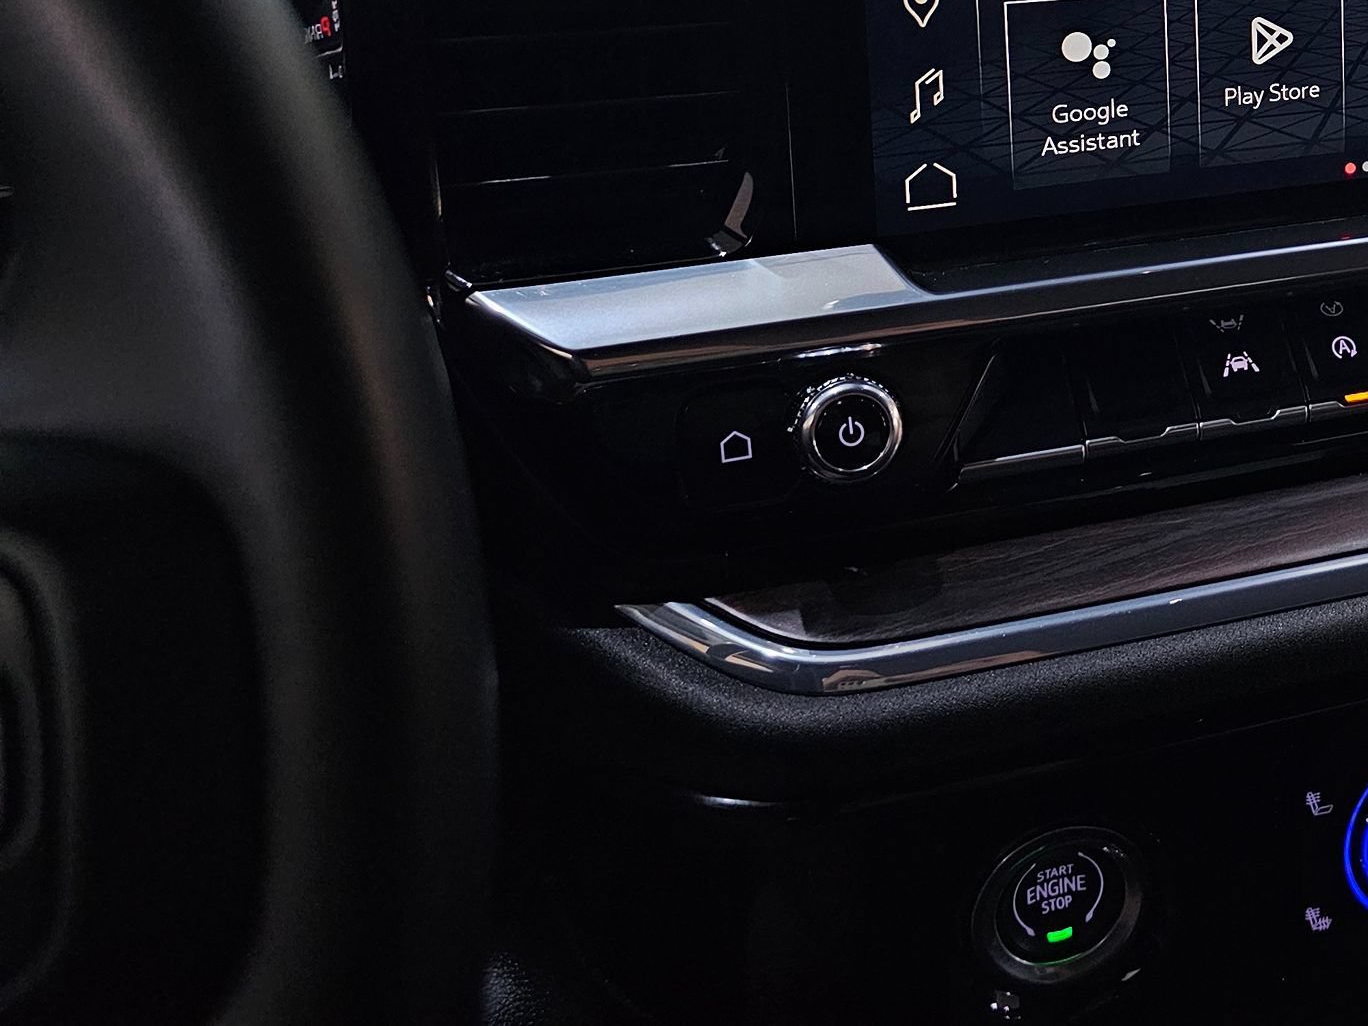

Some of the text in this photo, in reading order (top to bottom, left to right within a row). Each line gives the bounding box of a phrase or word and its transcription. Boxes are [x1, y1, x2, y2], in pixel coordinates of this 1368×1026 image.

[1225, 83, 1319, 109] Play Store
[1052, 98, 1128, 125] Google
[1042, 130, 1140, 156] Assistant
[1037, 864, 1074, 882] START
[1027, 875, 1086, 905] ENGINE
[1042, 895, 1073, 914] STOP
